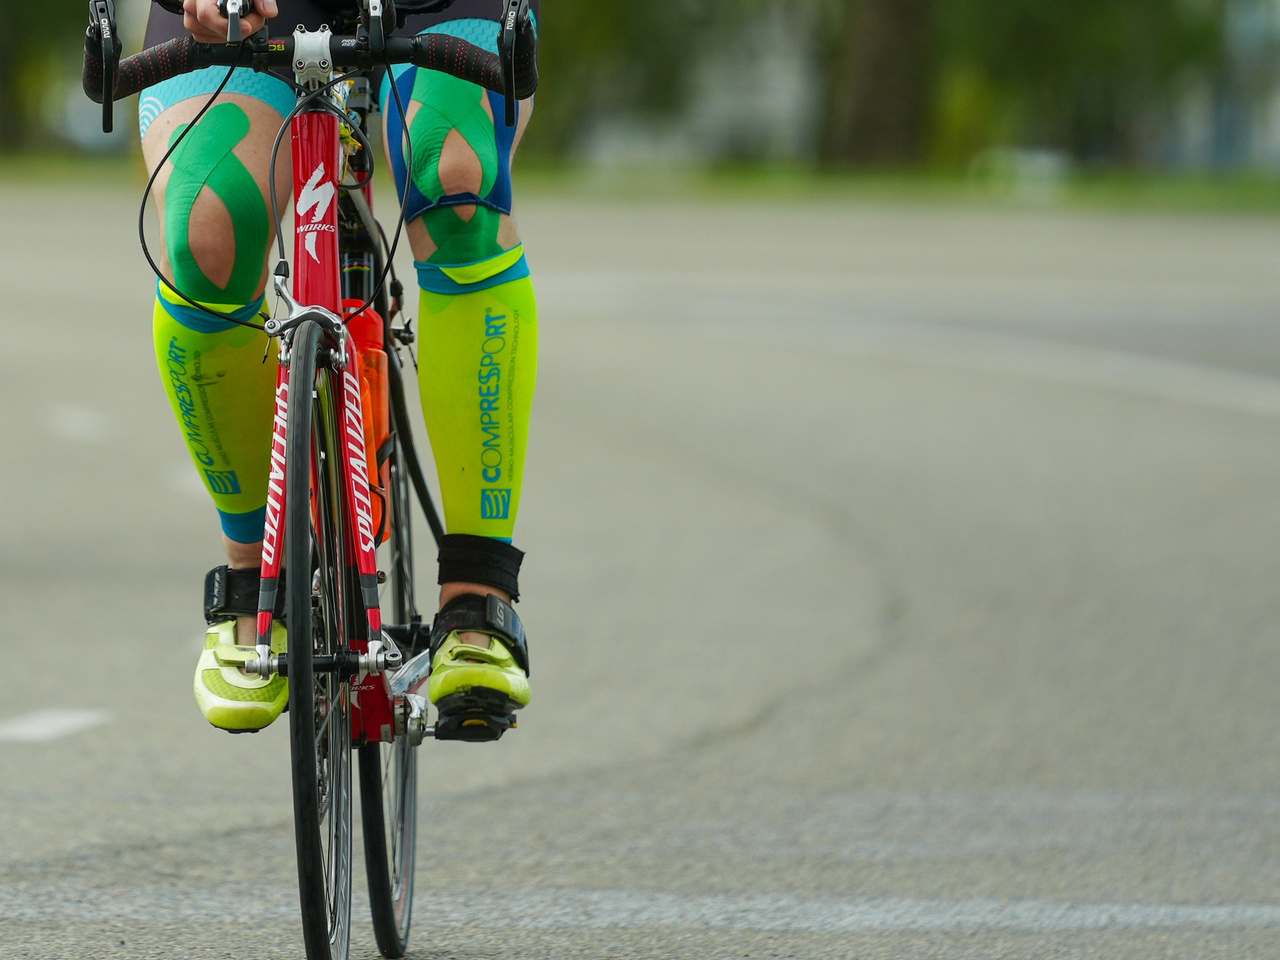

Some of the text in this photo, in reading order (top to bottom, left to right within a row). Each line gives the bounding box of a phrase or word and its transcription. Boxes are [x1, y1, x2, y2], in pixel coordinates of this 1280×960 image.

[297, 223, 336, 234] WORKS
[168, 342, 214, 467] COMPRESSPORT
[261, 382, 289, 565] SPECIALIZED
[342, 370, 376, 553] SPECIALIZED
[479, 314, 507, 483] COMPRESSPORT
